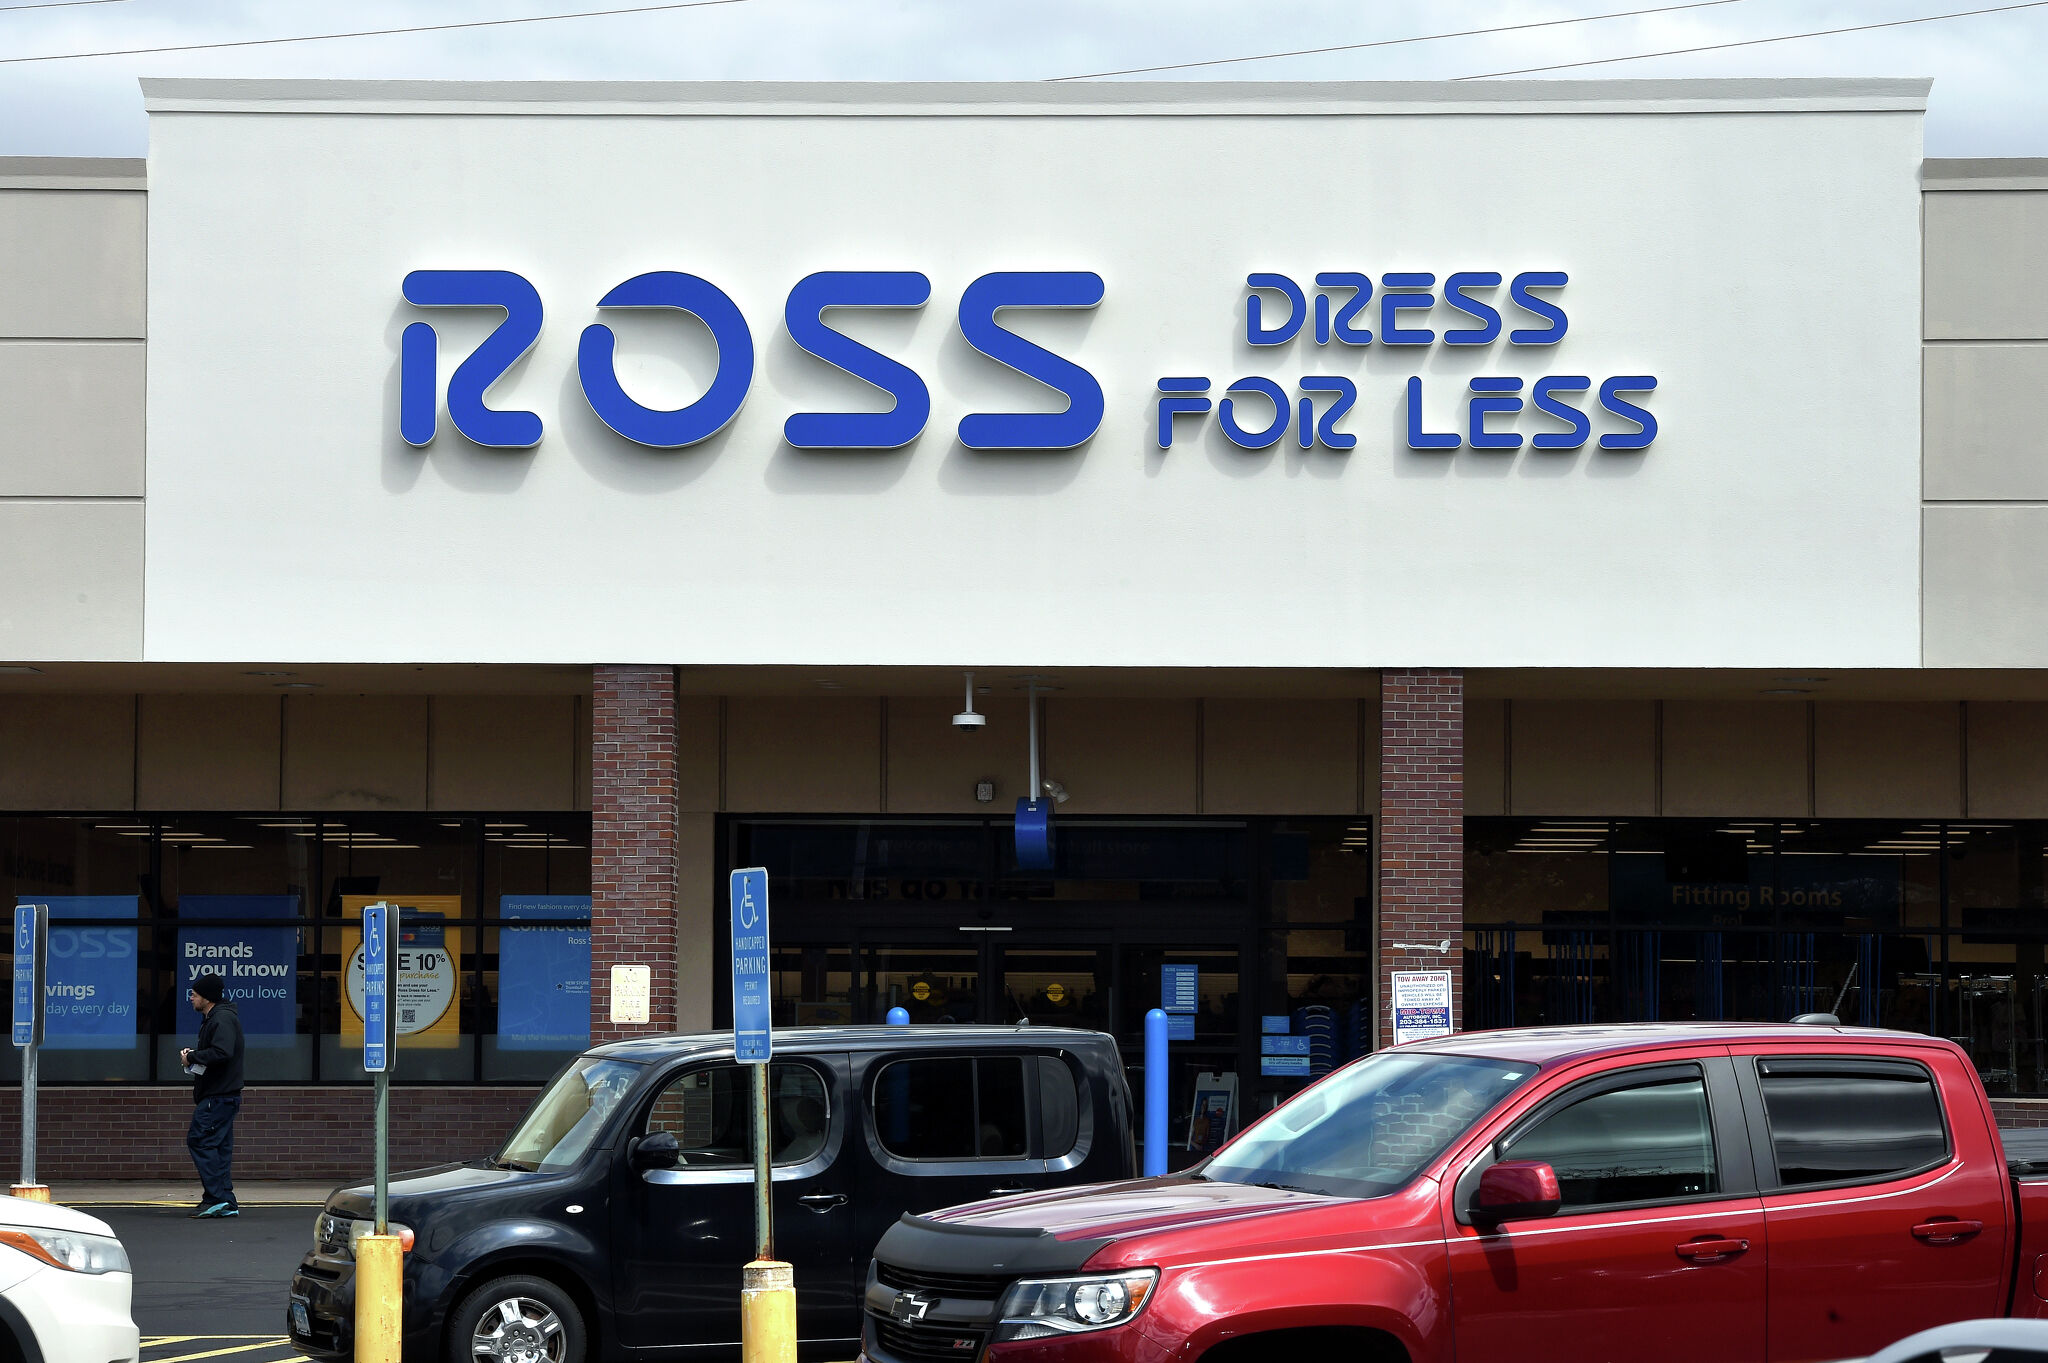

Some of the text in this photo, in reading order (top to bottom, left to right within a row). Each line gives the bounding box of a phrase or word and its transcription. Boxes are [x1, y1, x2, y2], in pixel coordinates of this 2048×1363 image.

[1245, 272, 1569, 346] DRESS
[401, 270, 1105, 449] ROSS
[1157, 376, 1658, 449] FOR LESS
[1672, 885, 1751, 911] Fitting
[49, 929, 132, 958] OSS
[185, 942, 253, 957] Brands
[736, 936, 765, 950] HANDICAPPED
[189, 961, 288, 980] you know
[416, 953, 445, 970] 10%
[736, 956, 766, 975] PARKING
[399, 970, 440, 981] purchase
[46, 982, 95, 1000] vings
[228, 988, 254, 1001] you
[258, 985, 287, 998] love
[71, 1004, 103, 1016] every
[107, 1002, 129, 1016] day
